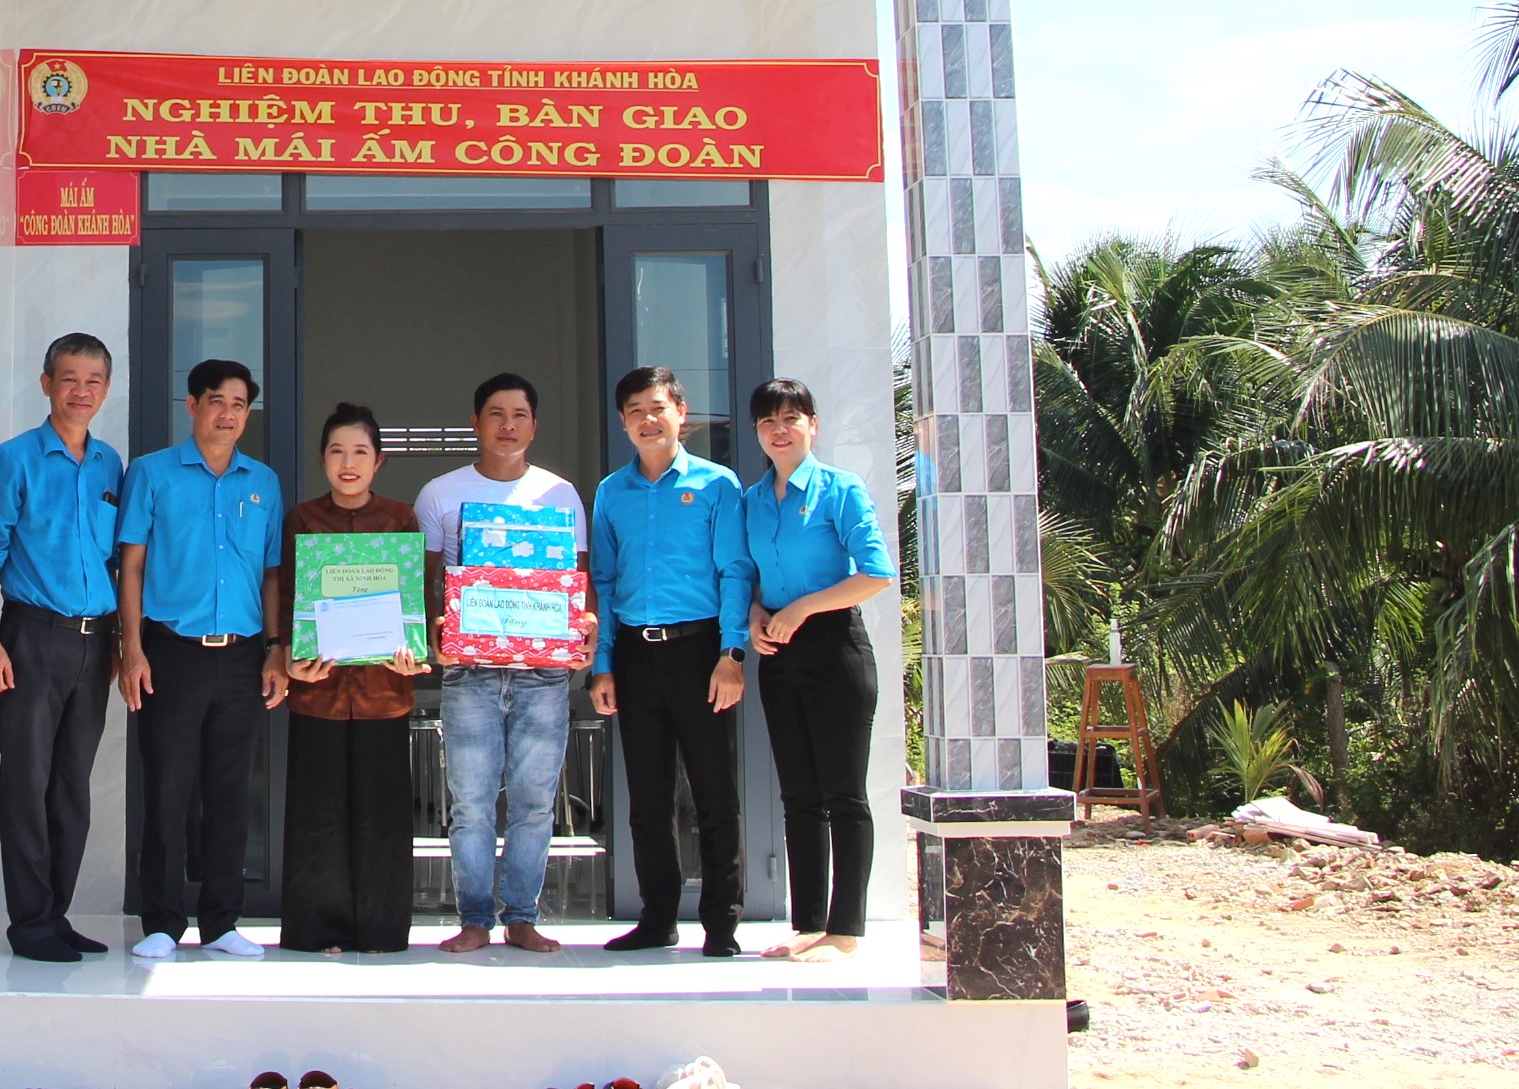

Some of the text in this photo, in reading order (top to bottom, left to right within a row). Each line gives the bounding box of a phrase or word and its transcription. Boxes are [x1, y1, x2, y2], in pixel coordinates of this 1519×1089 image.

[218, 63, 699, 89] LIÊN ĐOÀN LAO ĐỘNG TỈNH KHÁNH HÒA
[122, 94, 748, 130] NGHIỆM THU, BÀN GIAO
[106, 128, 765, 168] NHÀ MÁI ẤM CÔNG ĐOÀN
[60, 177, 95, 207] MÁI ẤM
[50, 209, 76, 235] ĐOÀN
[77, 209, 110, 235] KHÁNH
